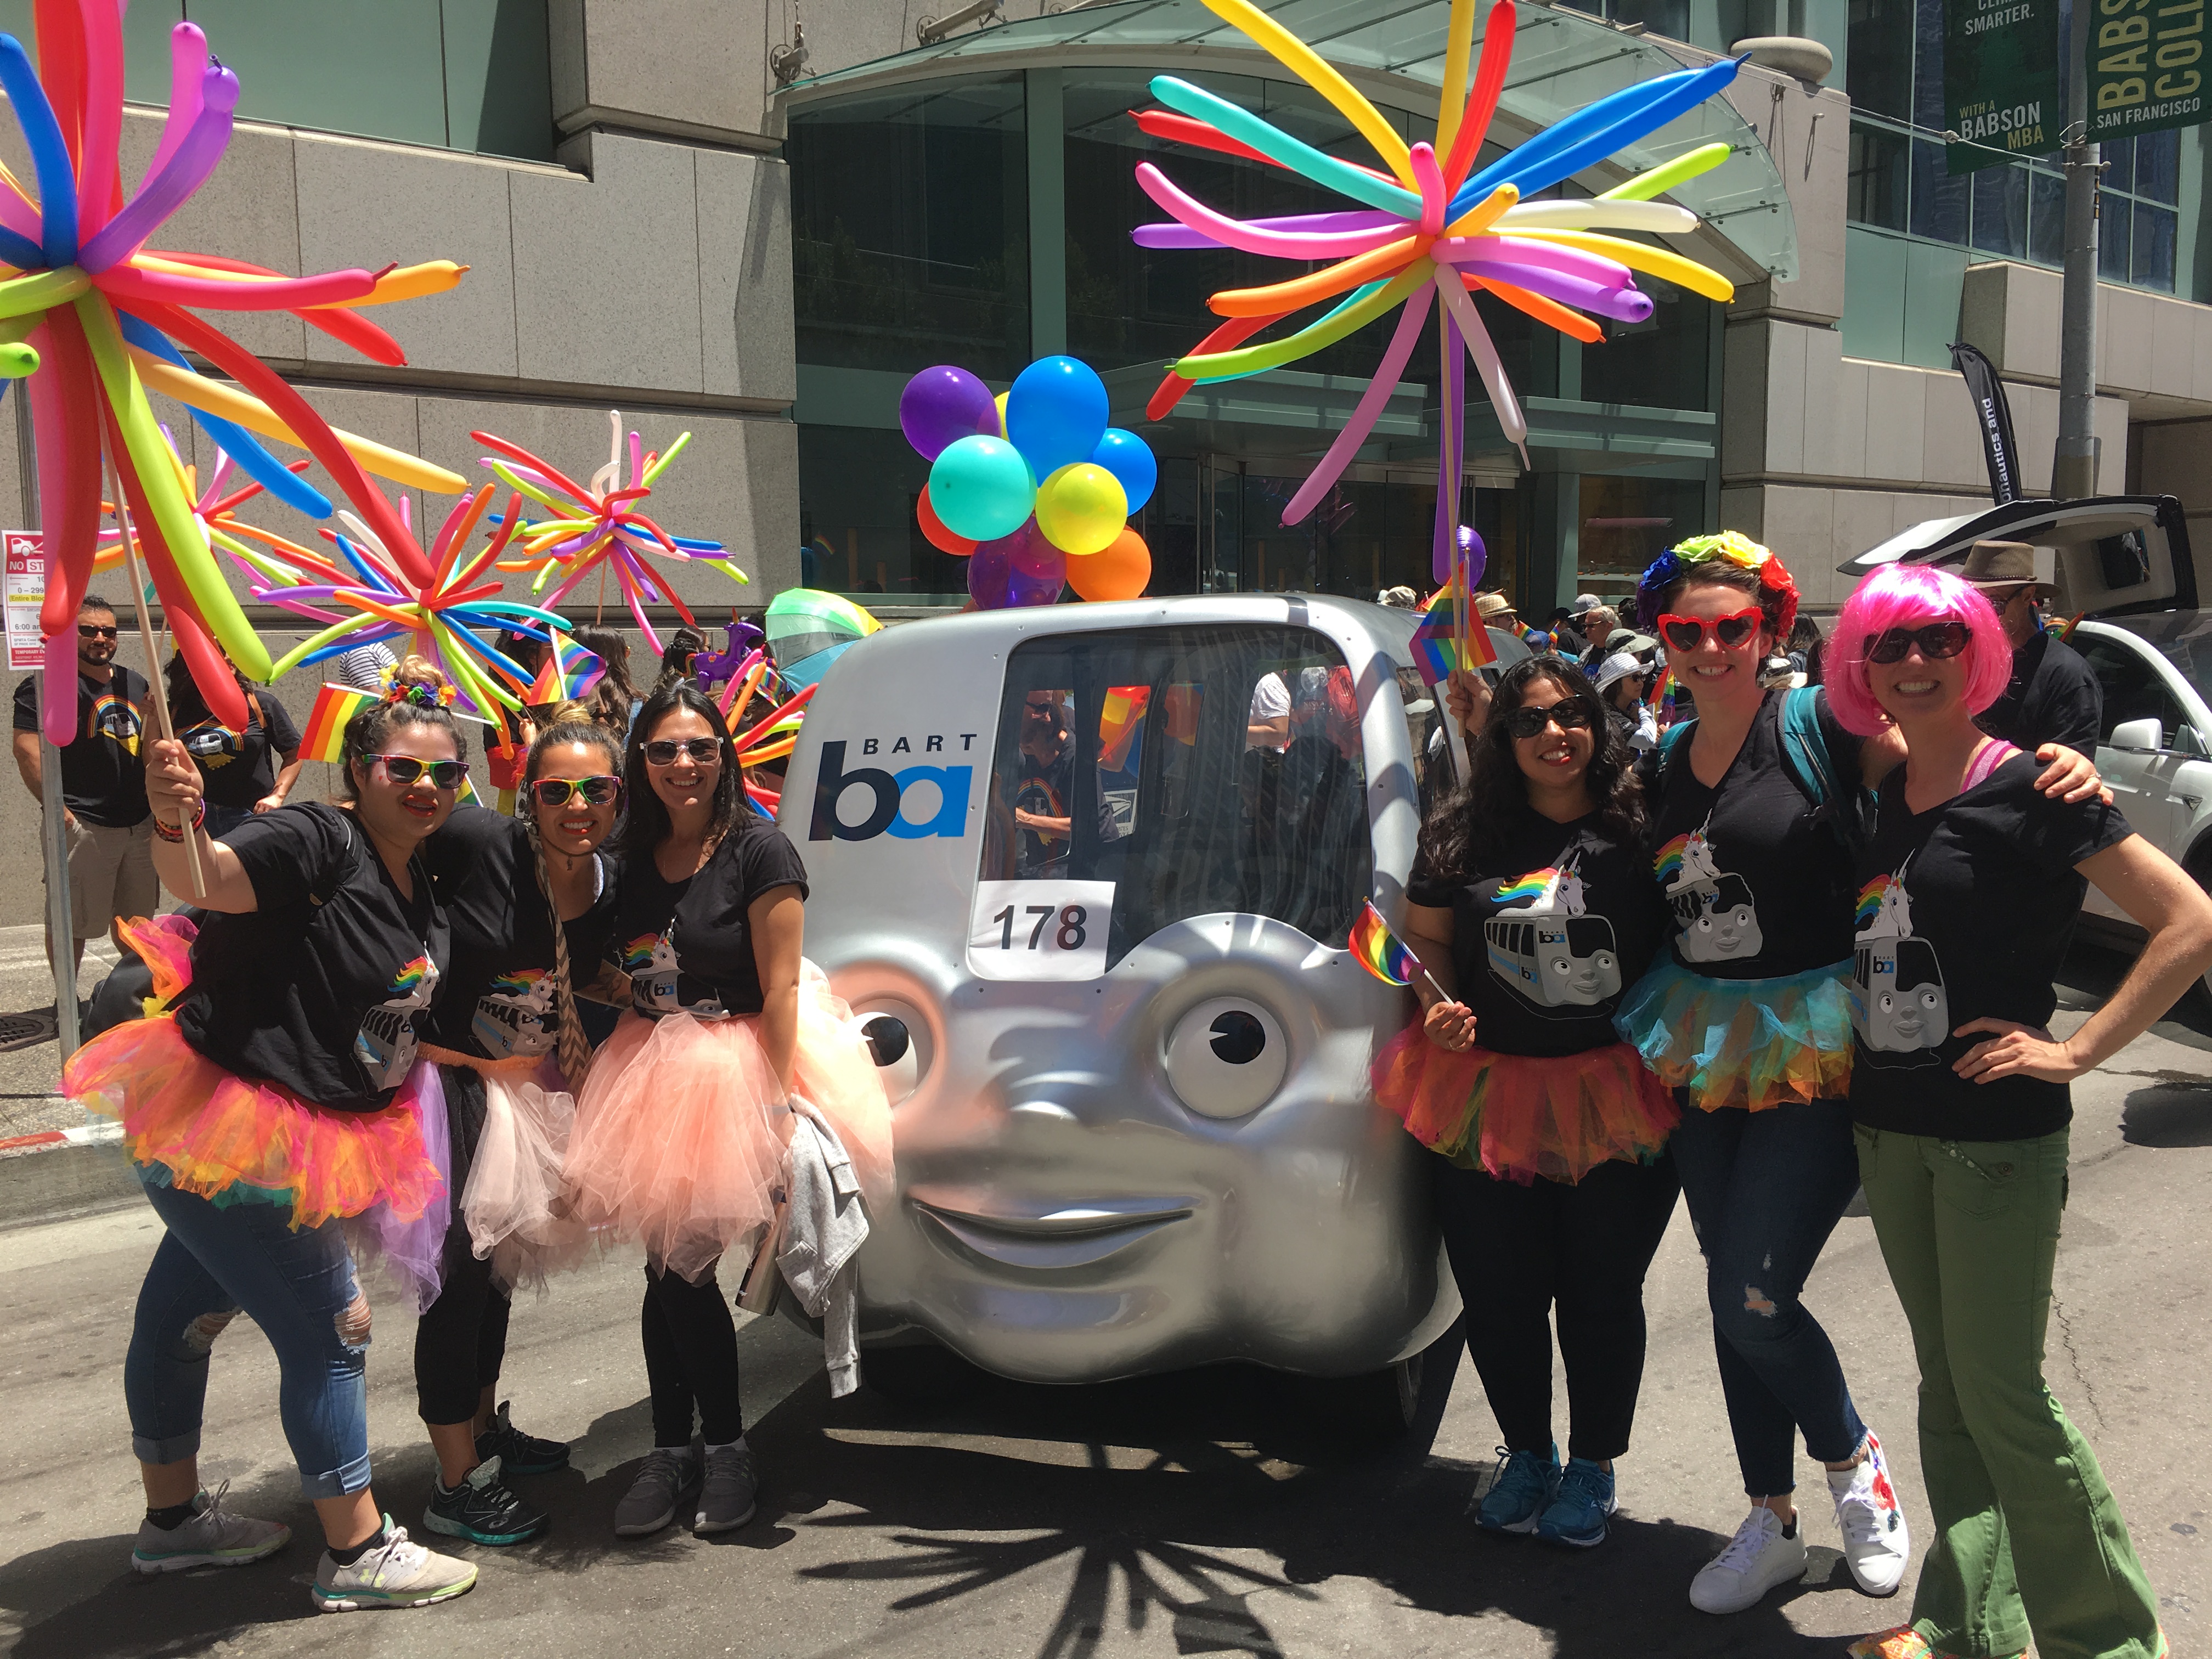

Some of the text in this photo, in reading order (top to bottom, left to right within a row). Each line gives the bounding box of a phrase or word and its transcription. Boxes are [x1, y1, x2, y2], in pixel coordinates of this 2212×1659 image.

[1965, 3, 2034, 35] SMARTER.
[1978, 0, 2012, 10] CL
[1959, 99, 1996, 119] WITH A
[1961, 101, 2041, 141] BABSON
[2097, 97, 2200, 128] SAN FRANCISCO
[2007, 125, 2044, 150] MBA
[1982, 398, 1997, 429] and
[9, 561, 44, 571] NO ST
[863, 734, 977, 755] BART
[808, 741, 973, 842] ba
[994, 905, 1087, 951] 178
